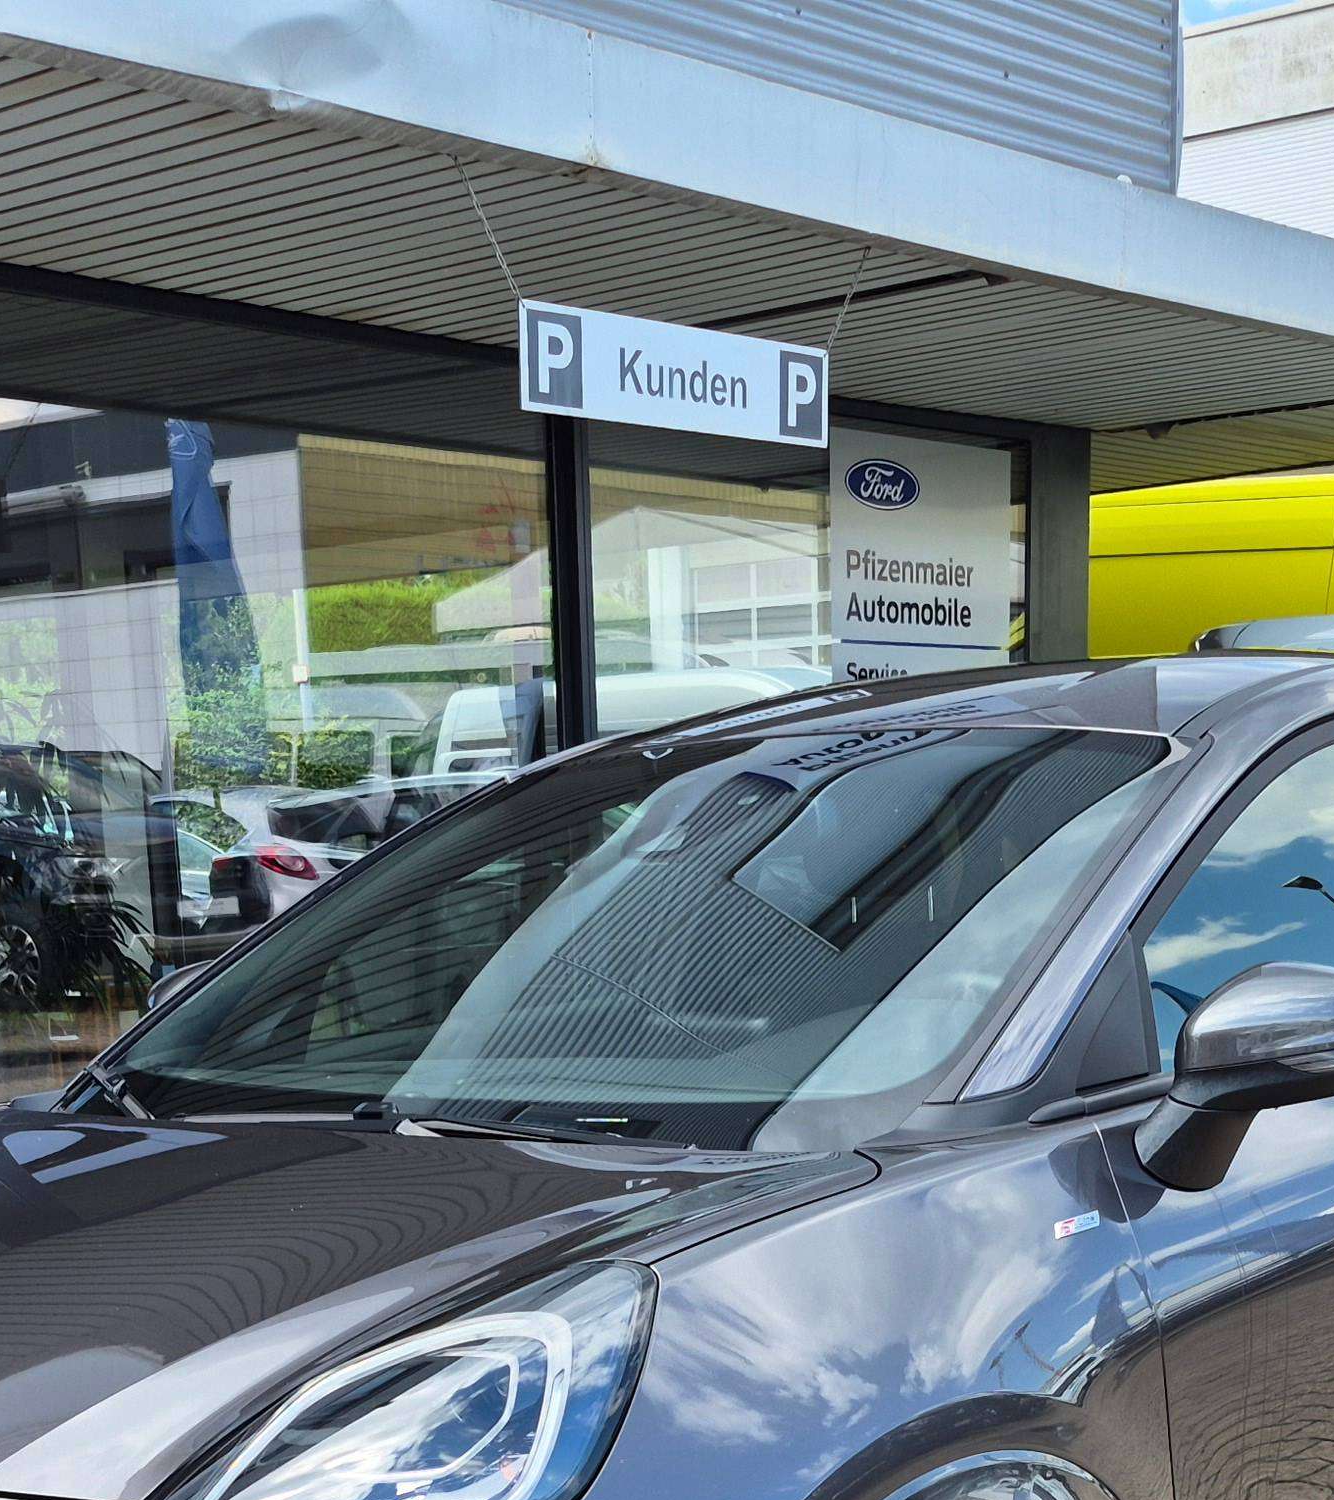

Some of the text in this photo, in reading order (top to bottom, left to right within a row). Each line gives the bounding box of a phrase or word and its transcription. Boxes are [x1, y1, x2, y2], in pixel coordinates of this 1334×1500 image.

[537, 321, 818, 428] P Kunden P
[846, 549, 974, 590] Pfizenmaier
[846, 592, 972, 628] Automobile
